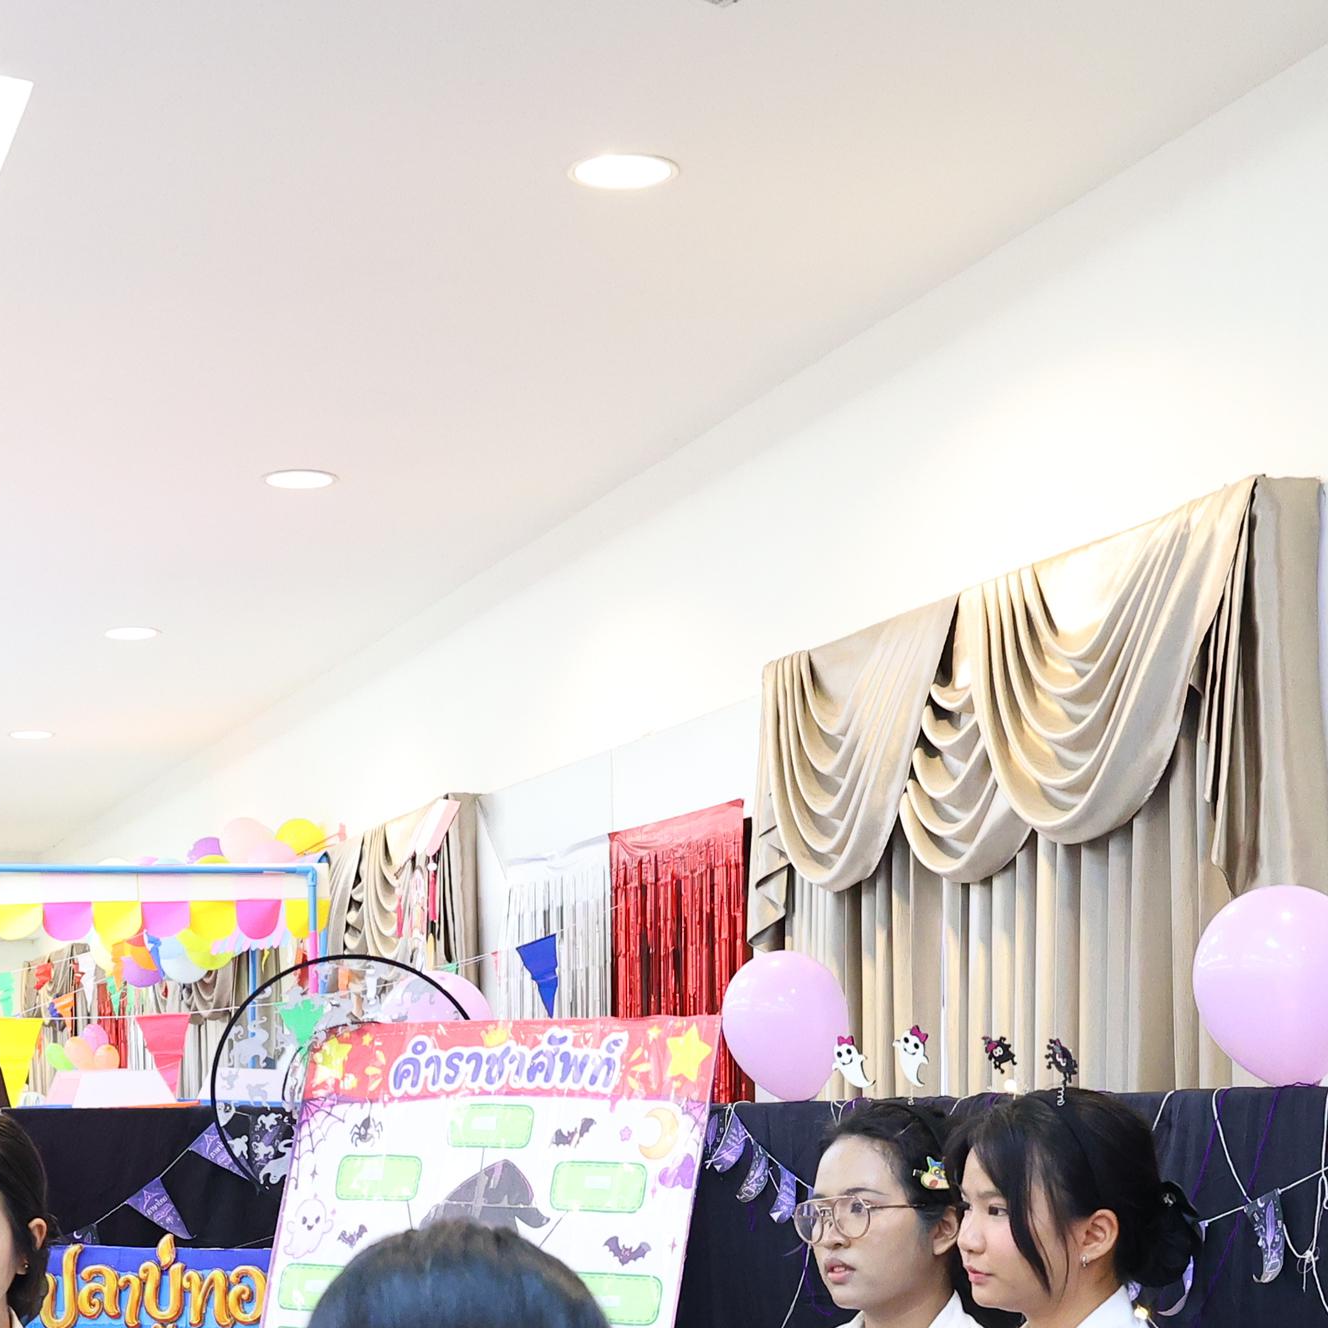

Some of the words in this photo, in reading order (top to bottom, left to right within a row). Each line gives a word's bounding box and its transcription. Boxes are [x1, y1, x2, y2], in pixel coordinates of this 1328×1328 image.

[391, 1031, 626, 1091] คำราชาศัพท์
